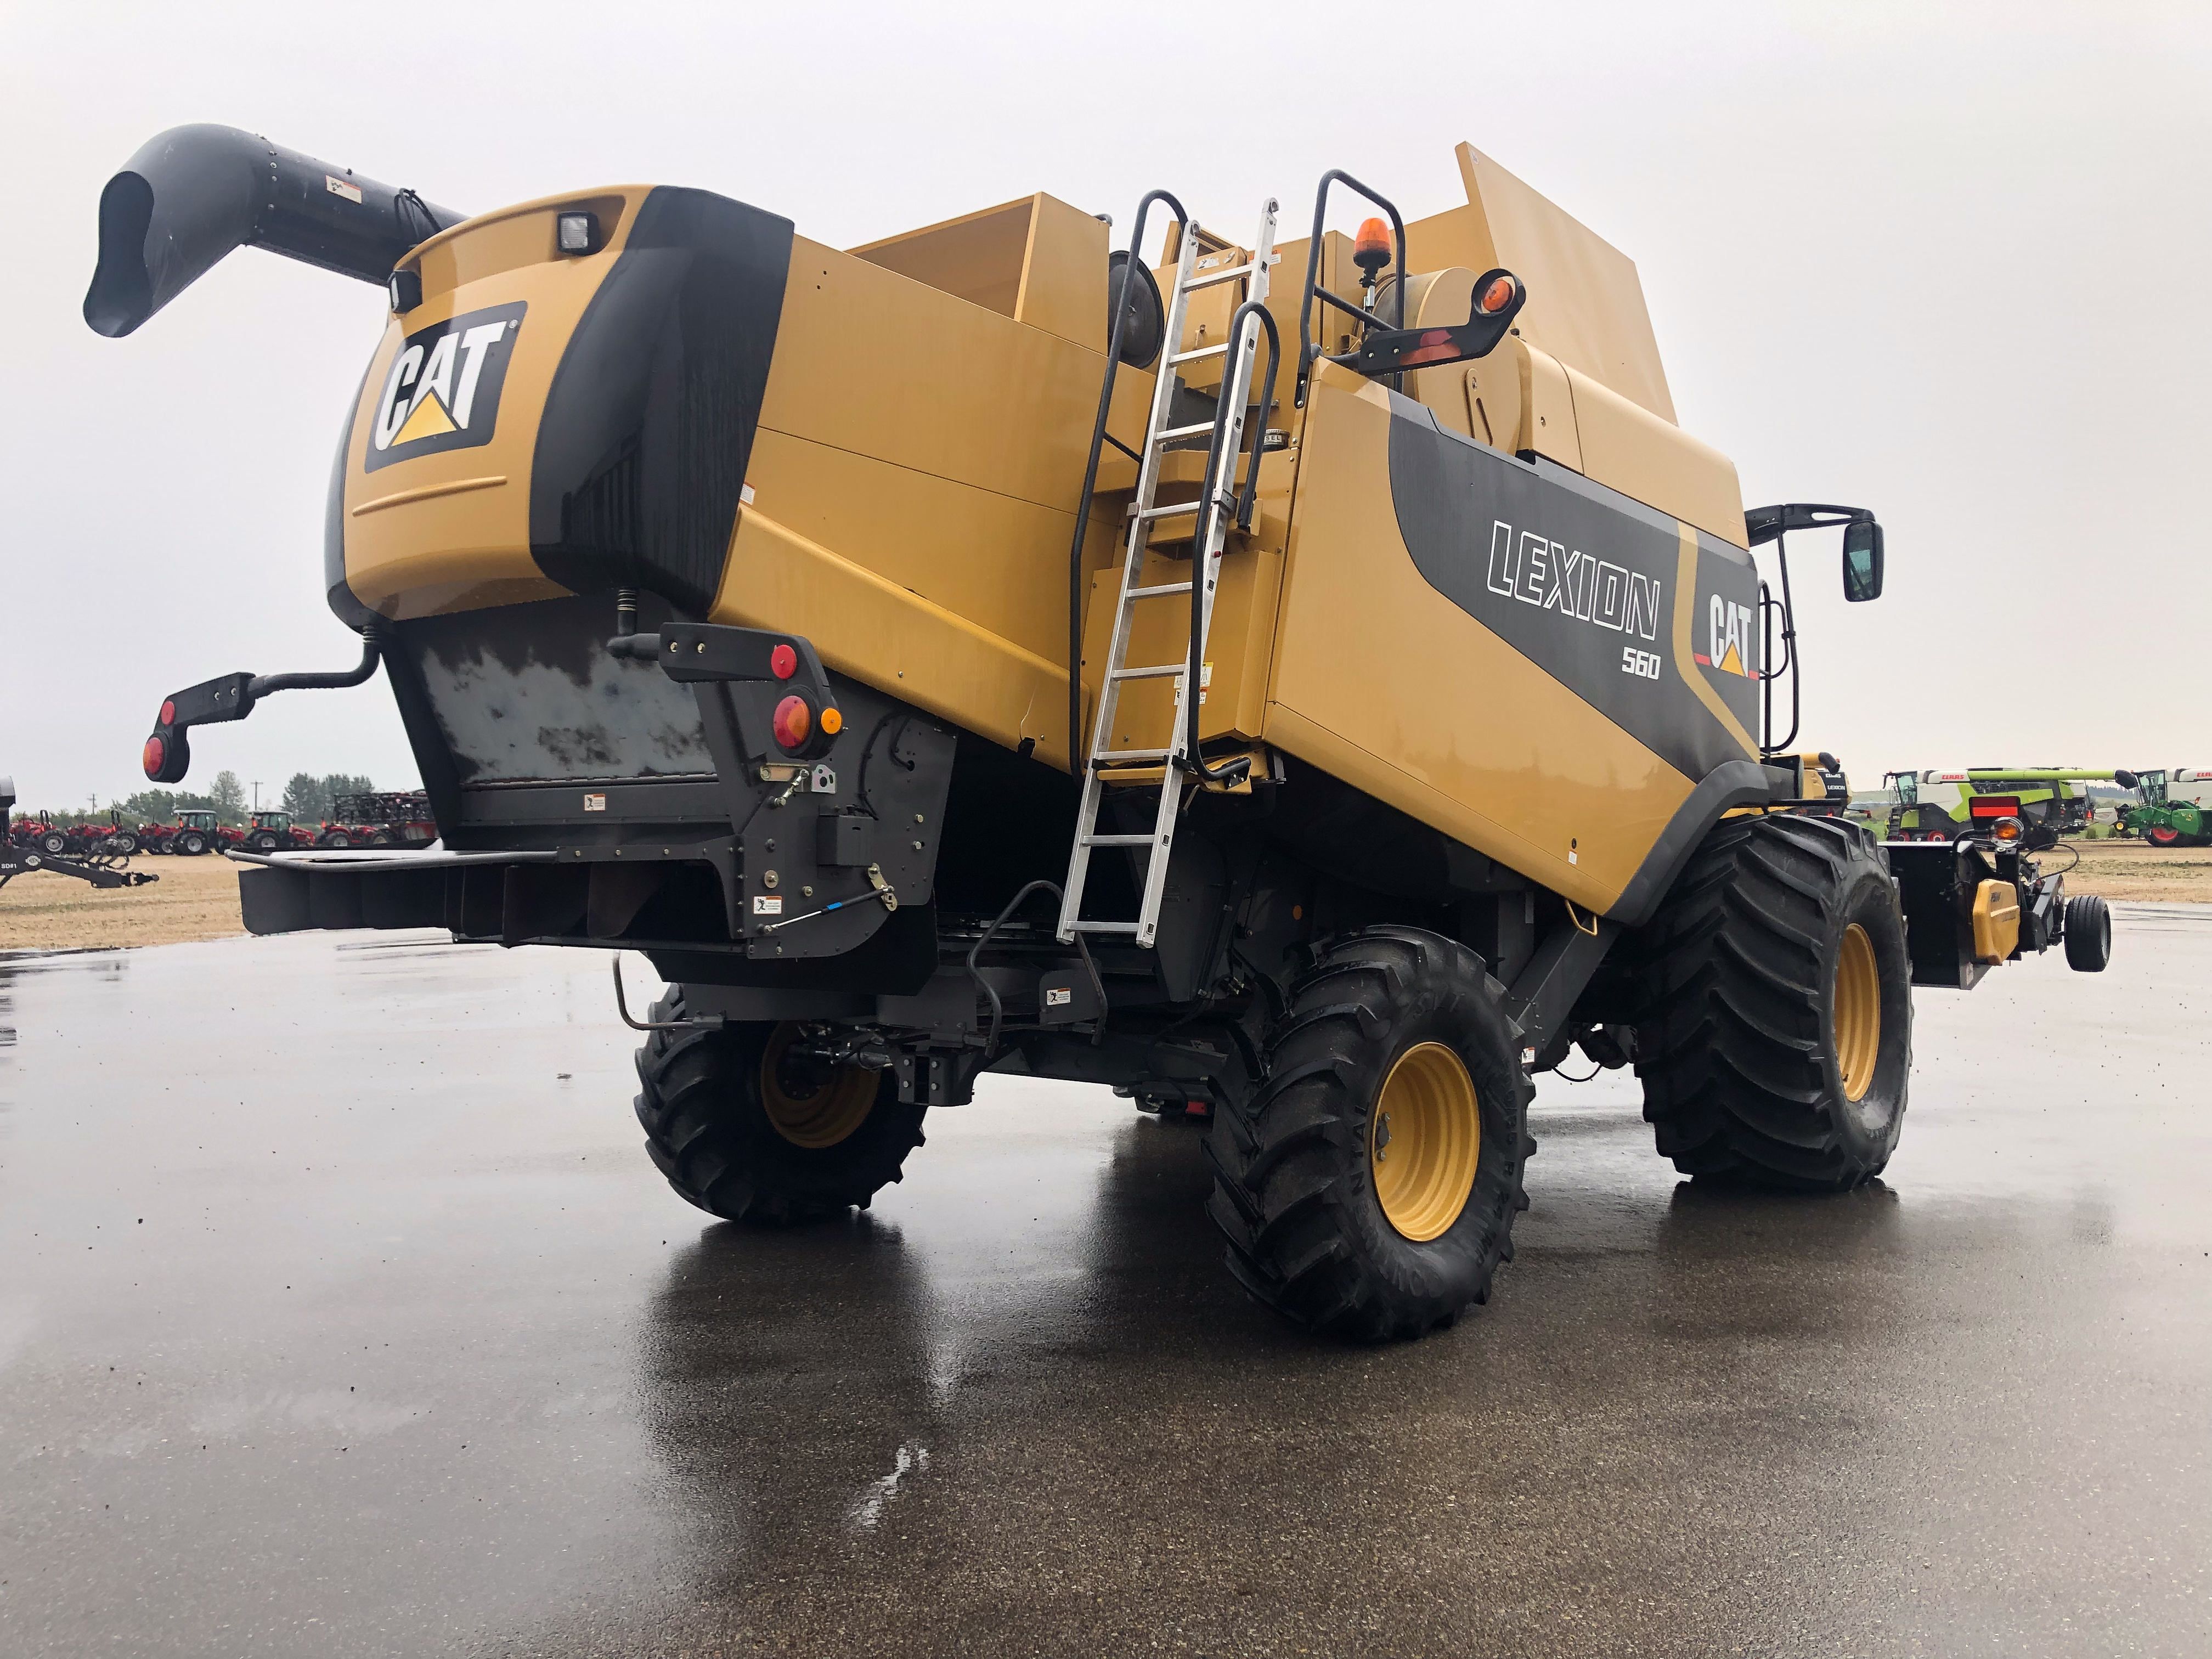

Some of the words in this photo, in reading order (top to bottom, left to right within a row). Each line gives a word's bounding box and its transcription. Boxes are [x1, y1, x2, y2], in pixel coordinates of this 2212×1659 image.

[375, 321, 507, 451] CAT
[1487, 520, 1661, 641] LEXION
[1621, 646, 1661, 680] 560
[1709, 594, 1752, 677] CAT
